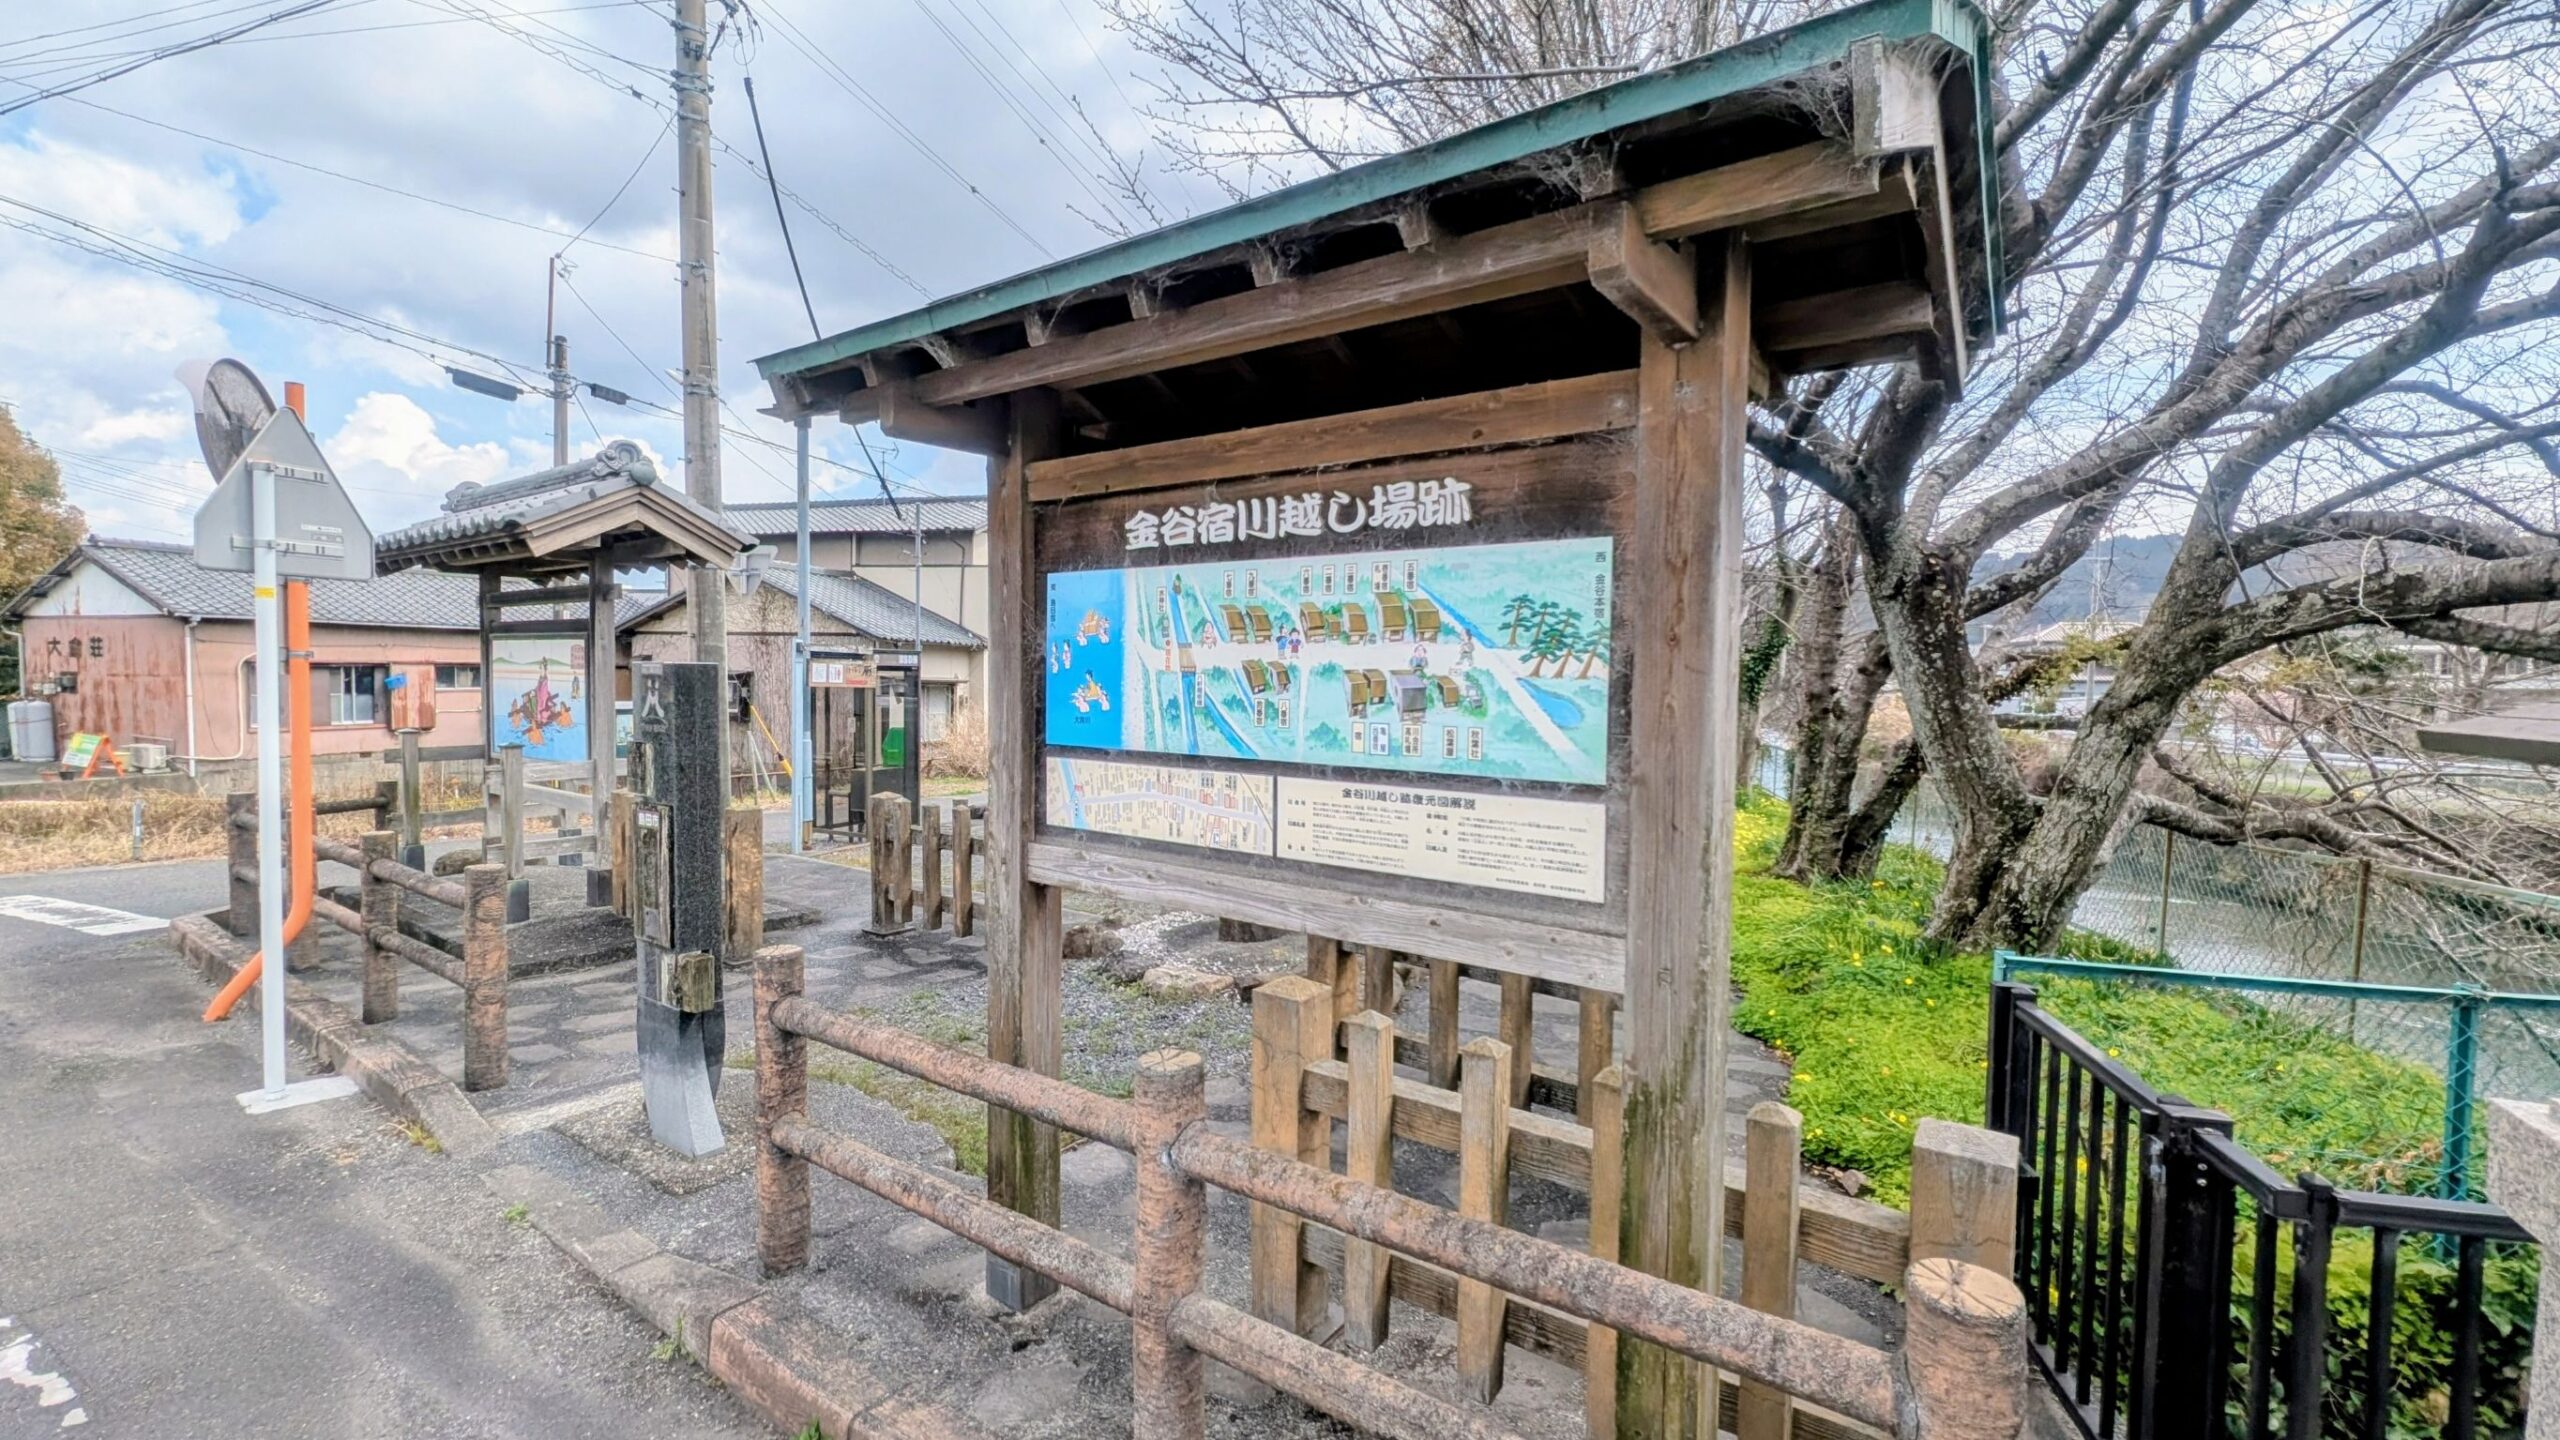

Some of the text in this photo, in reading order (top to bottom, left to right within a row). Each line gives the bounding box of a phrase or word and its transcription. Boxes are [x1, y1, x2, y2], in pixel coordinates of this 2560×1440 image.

[1125, 478, 1471, 550] 金谷宿川越し場跡
[1595, 552, 1606, 562] 西
